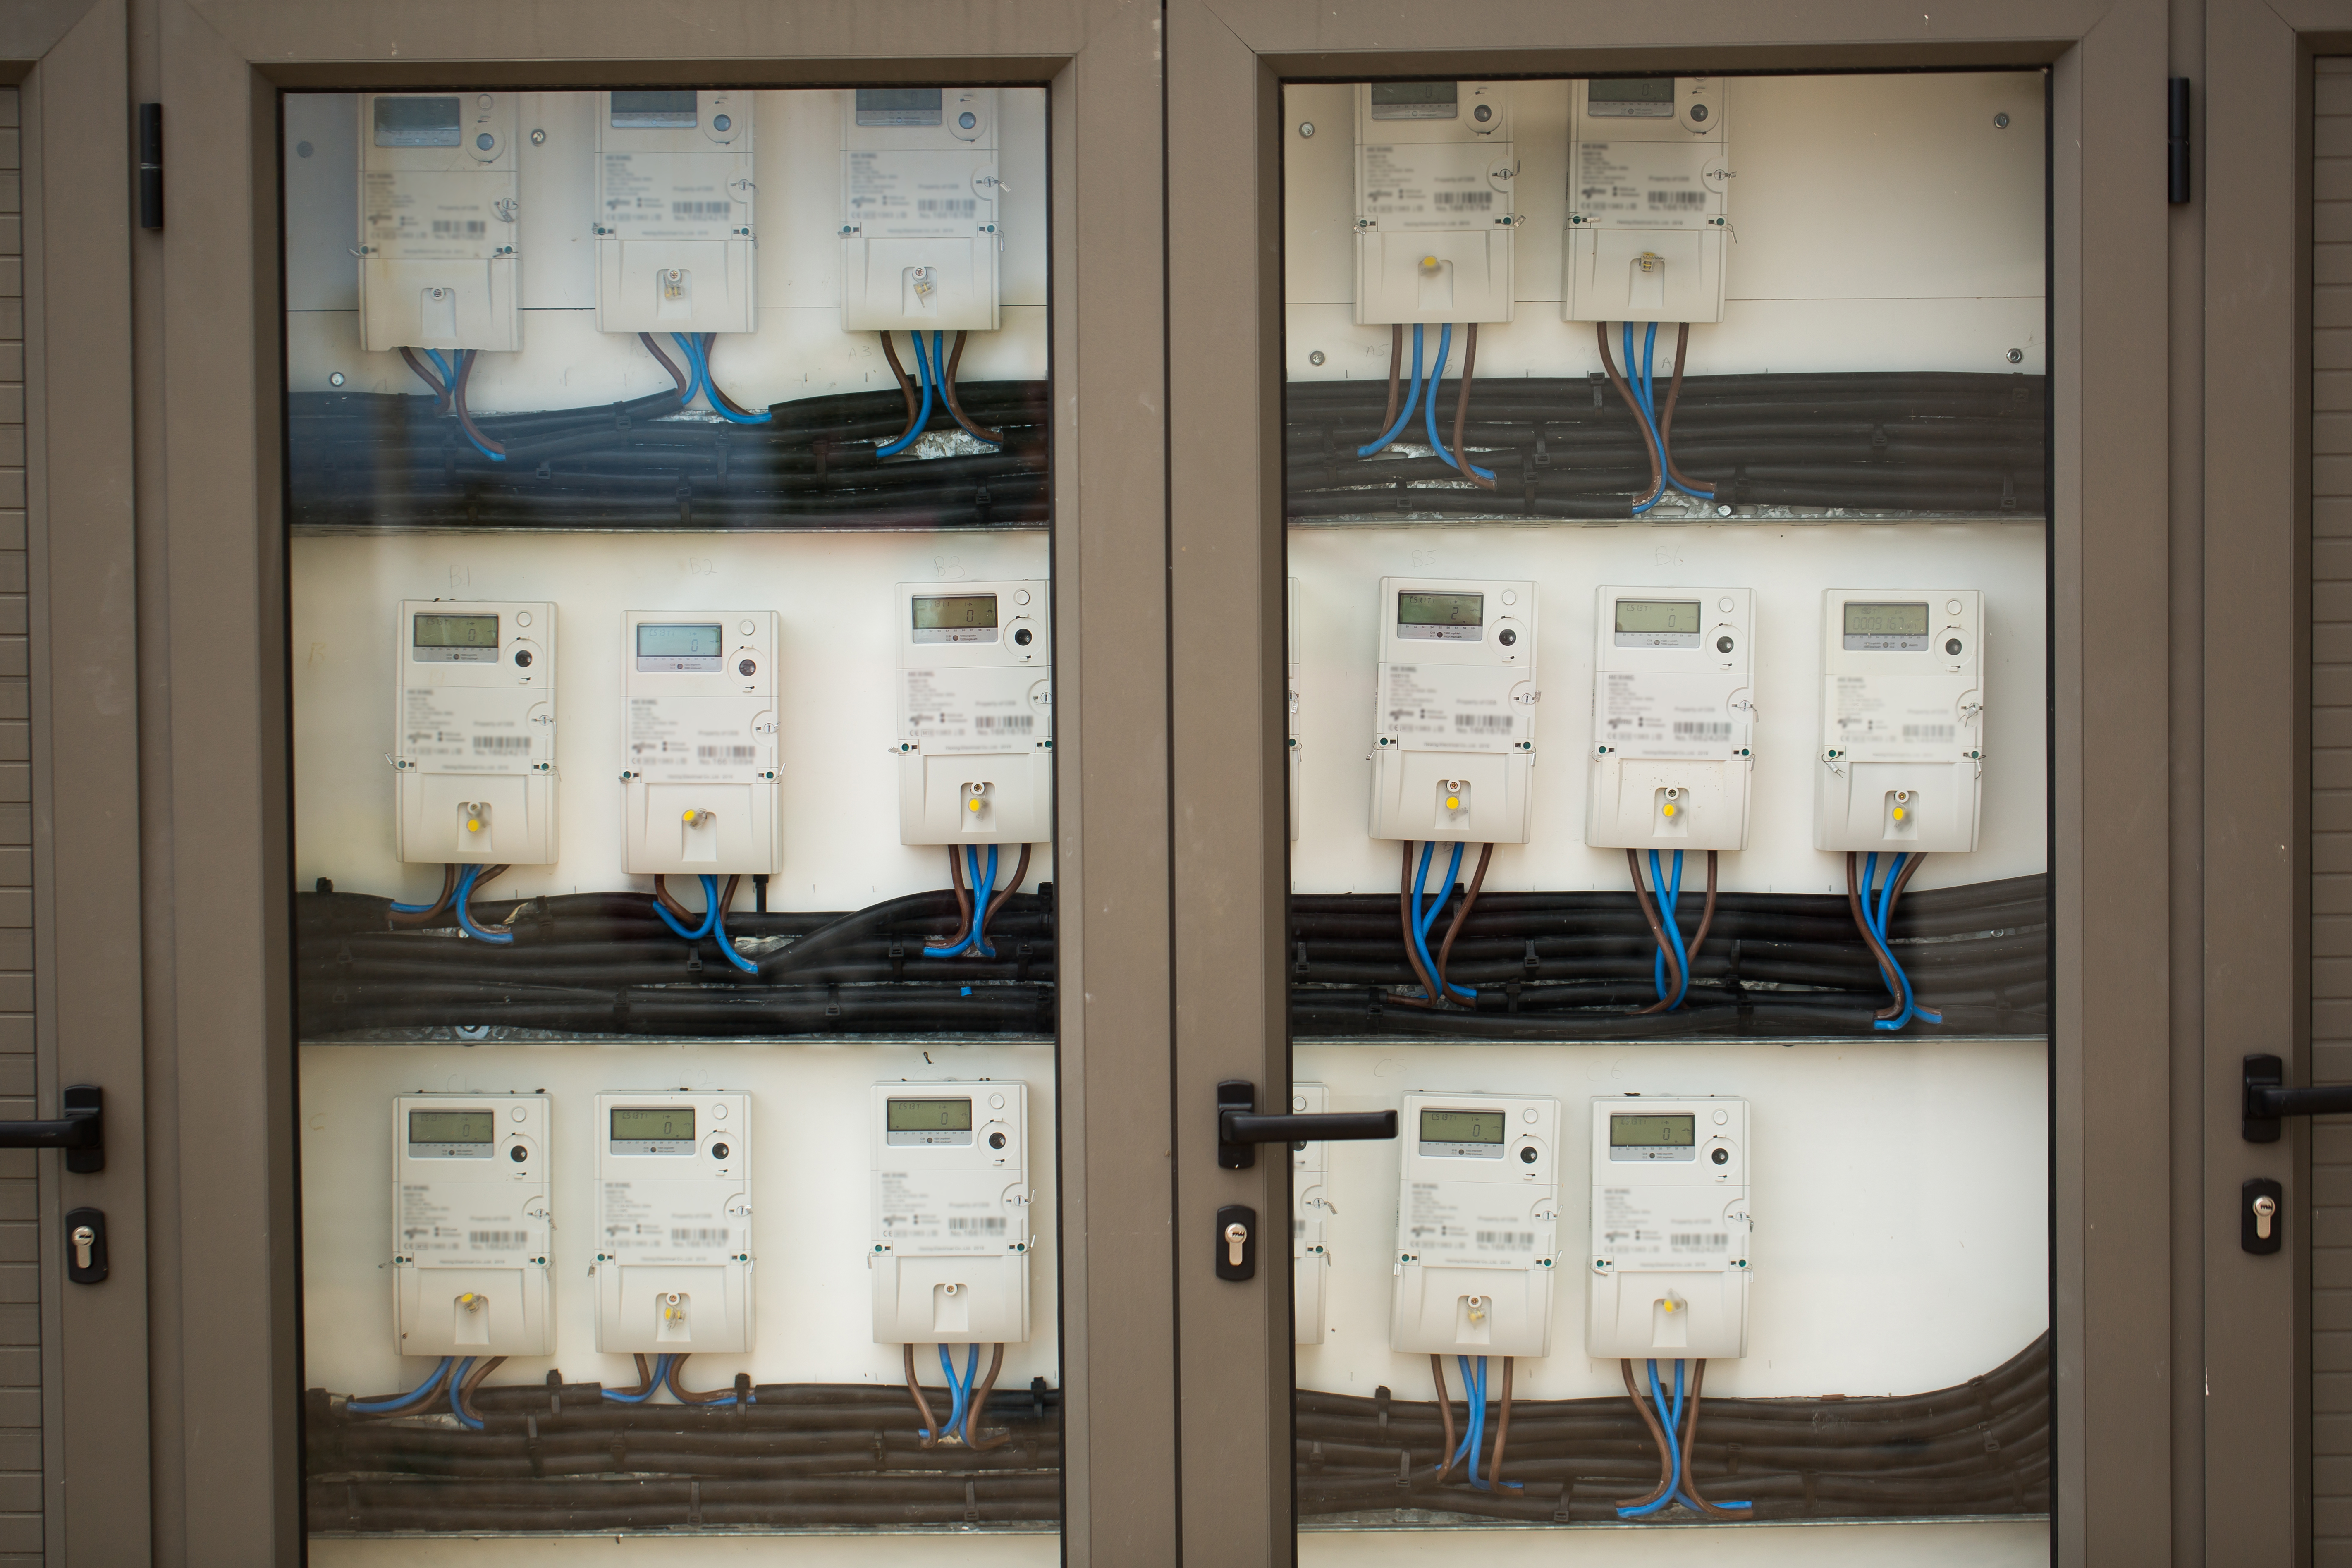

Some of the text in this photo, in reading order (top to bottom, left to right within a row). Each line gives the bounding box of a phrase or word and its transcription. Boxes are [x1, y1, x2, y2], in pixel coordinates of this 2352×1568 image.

[934, 556, 965, 579] B3
[966, 610, 974, 622] 0
[1451, 607, 1458, 620] 2
[1668, 615, 1676, 627] 0
[941, 1112, 948, 1125] 0
[664, 1122, 672, 1134] 0
[1473, 1124, 1480, 1137] 0
[1663, 1128, 1670, 1140] 0
